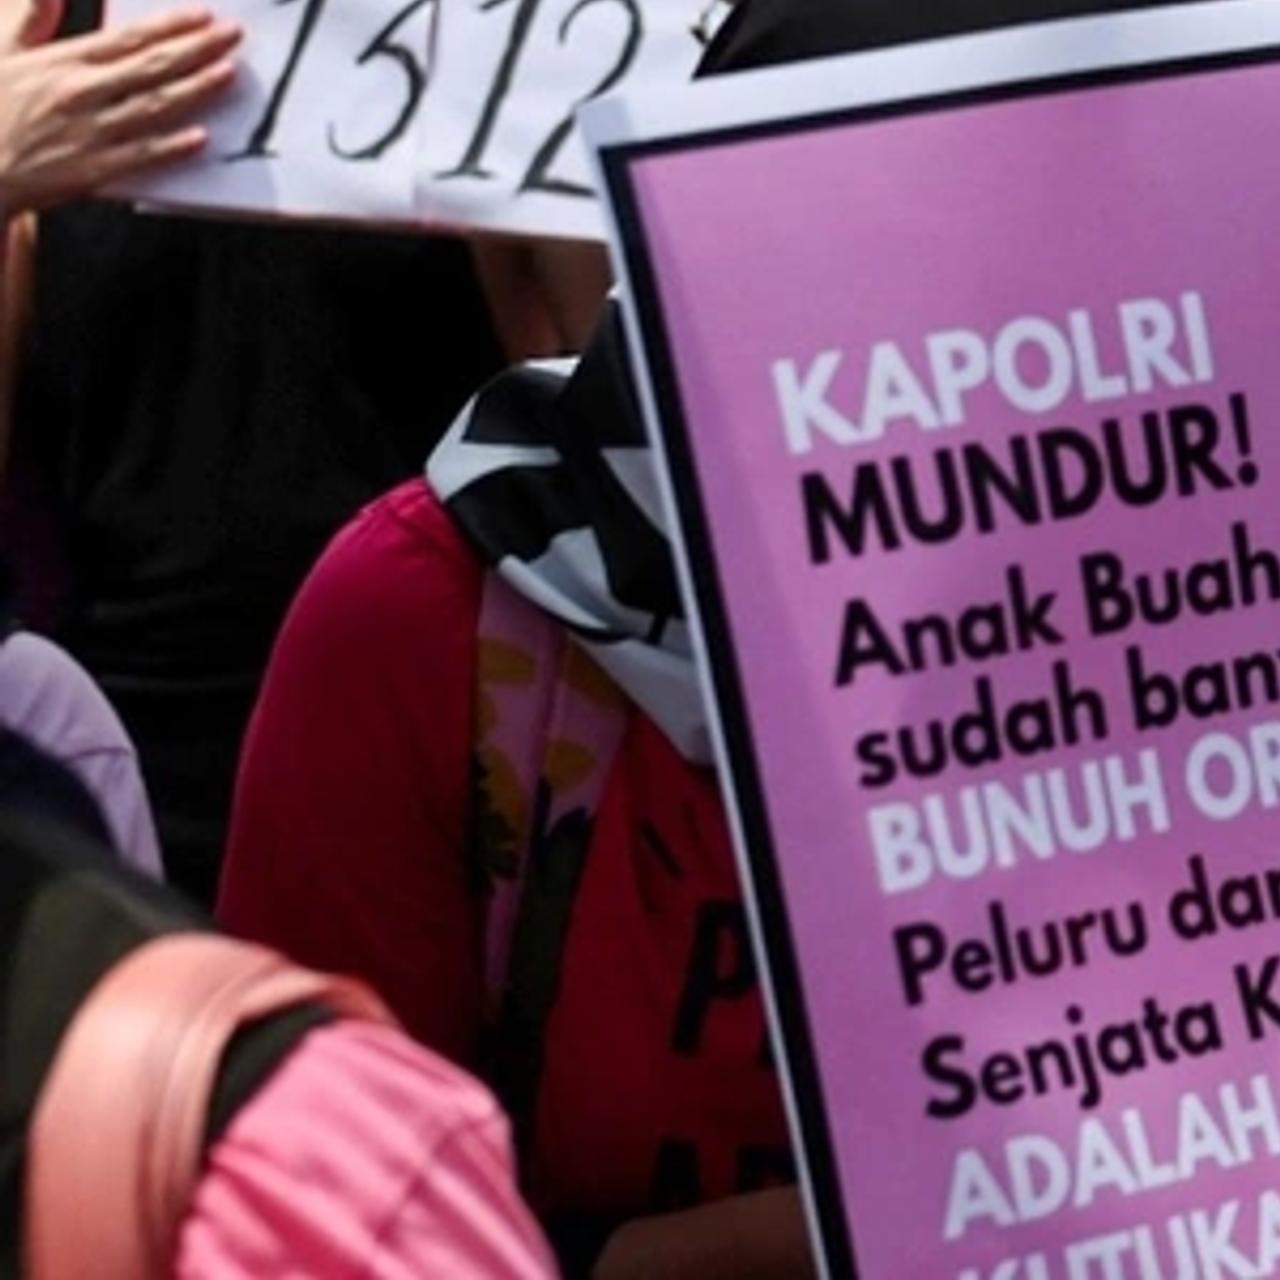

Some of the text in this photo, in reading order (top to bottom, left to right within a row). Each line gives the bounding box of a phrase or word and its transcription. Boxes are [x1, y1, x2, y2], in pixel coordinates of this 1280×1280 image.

[771, 290, 1216, 452] KAPOLRI
[801, 392, 1261, 564] MUNDUR!
[834, 563, 1064, 686] Anak
[855, 660, 1108, 790] sudah
[866, 748, 1172, 896] BUNUH
[891, 895, 1150, 1006] Peluru
[921, 1002, 1222, 1120] Senjata
